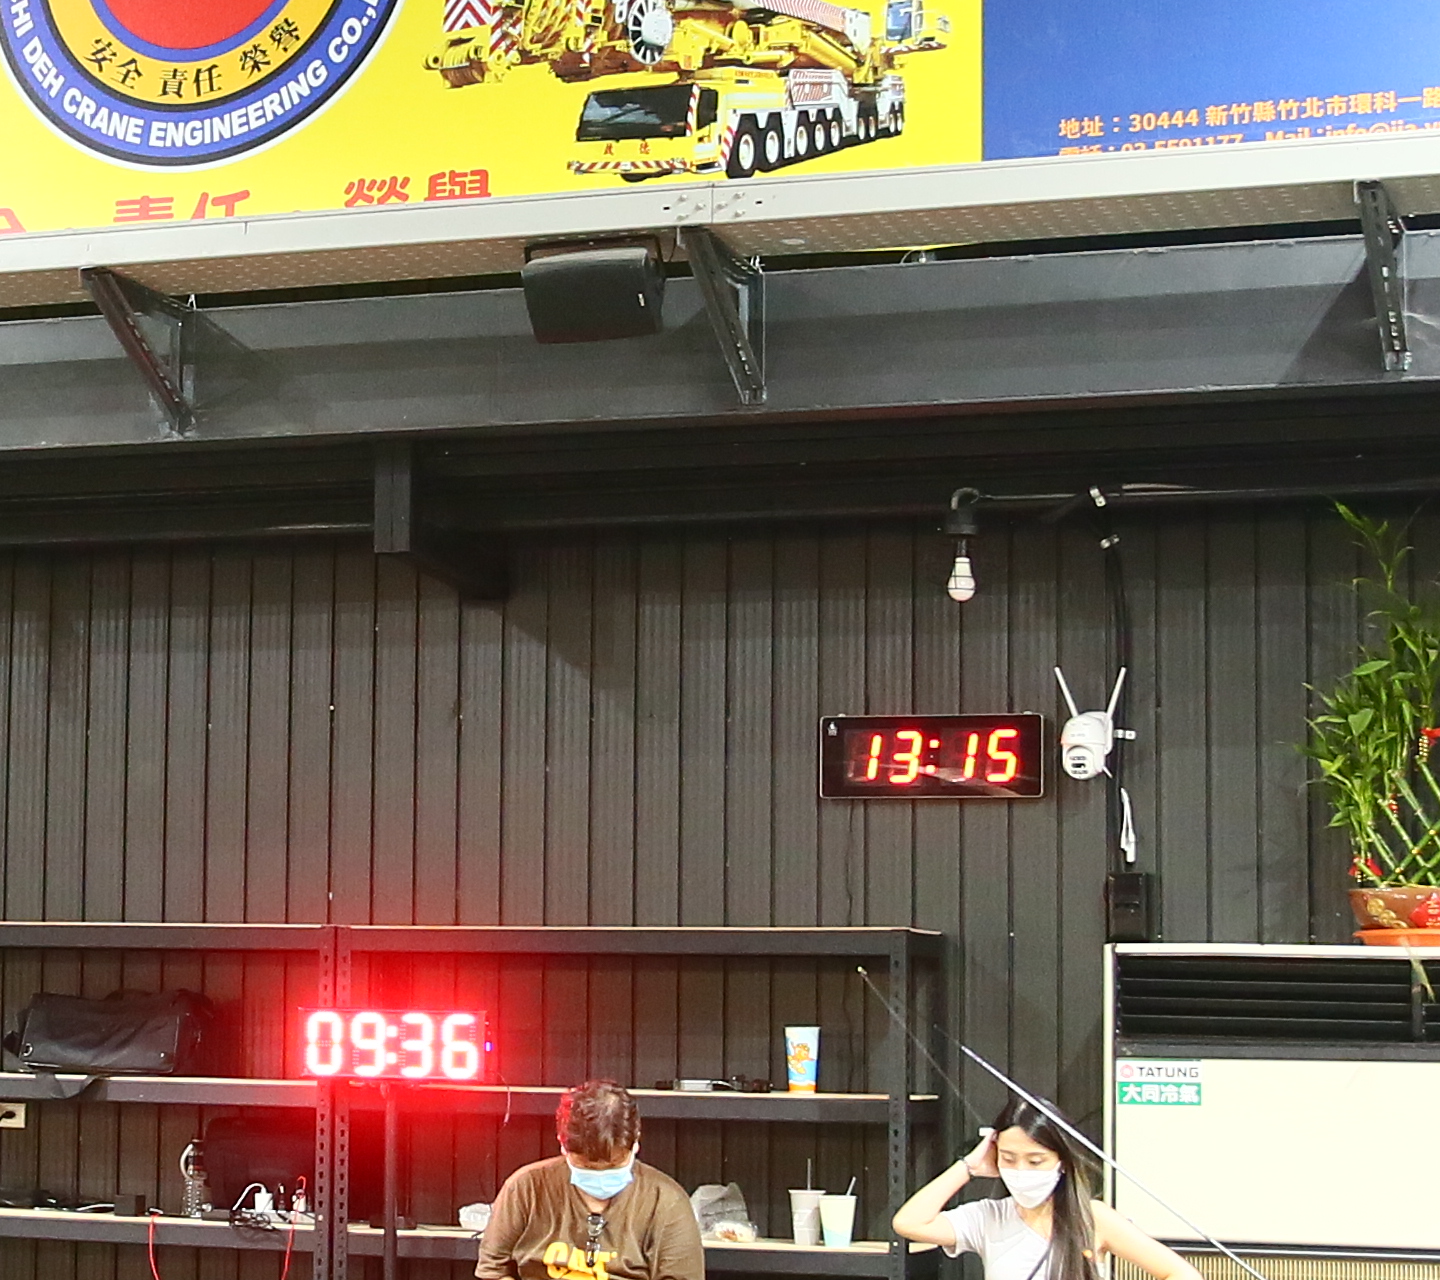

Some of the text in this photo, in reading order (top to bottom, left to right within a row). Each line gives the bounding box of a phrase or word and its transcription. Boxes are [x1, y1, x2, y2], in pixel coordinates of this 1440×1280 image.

[83, 16, 301, 100] 安全 責任 榮譽
[22, 39, 66, 96] DEH
[62, 88, 143, 145] CRANE
[147, 60, 329, 149] ENGINEERING
[866, 727, 1019, 784] 13:15
[304, 1010, 481, 1080] 09:36
[1136, 1066, 1200, 1078] TATUNG
[1122, 1083, 1200, 1104] 大同冷氣
